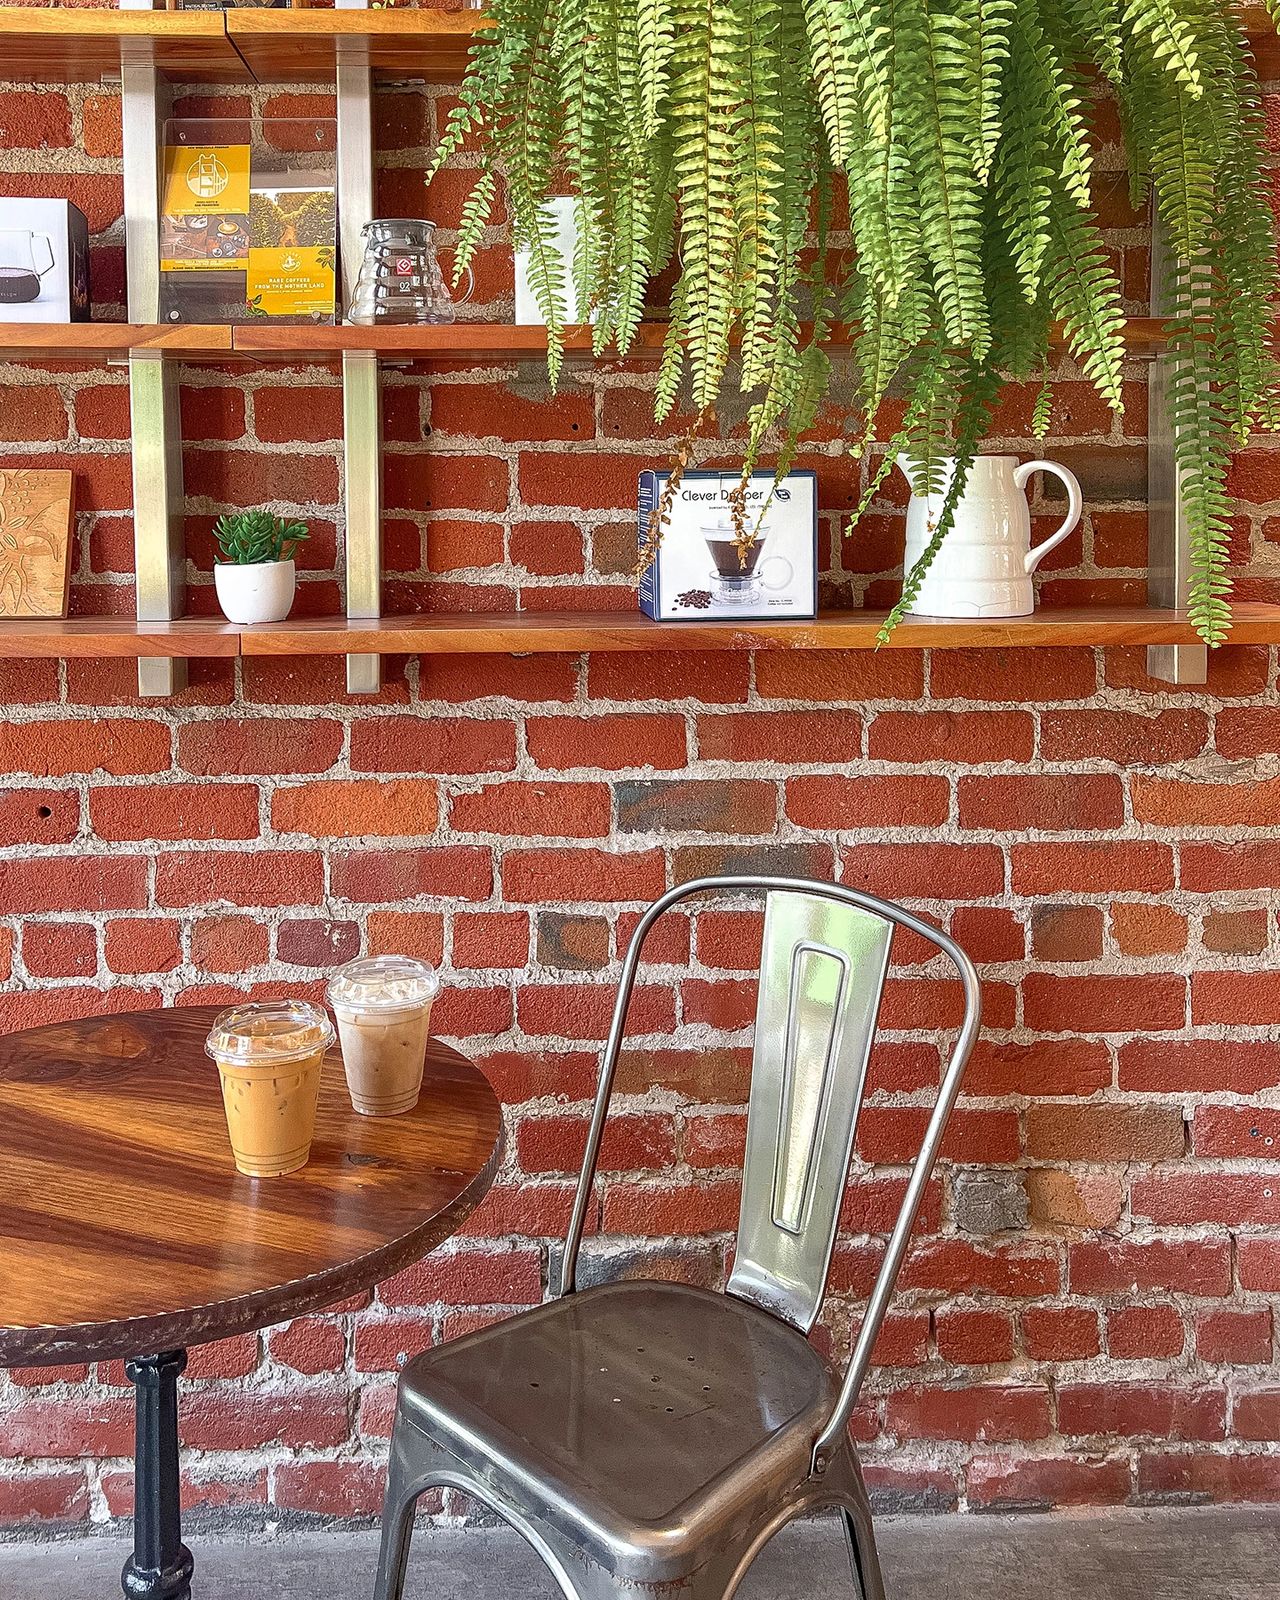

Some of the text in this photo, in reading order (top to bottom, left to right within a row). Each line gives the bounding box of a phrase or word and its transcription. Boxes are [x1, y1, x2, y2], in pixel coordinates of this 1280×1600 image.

[399, 281, 410, 290] 02
[681, 489, 764, 502] Clever Dpper
